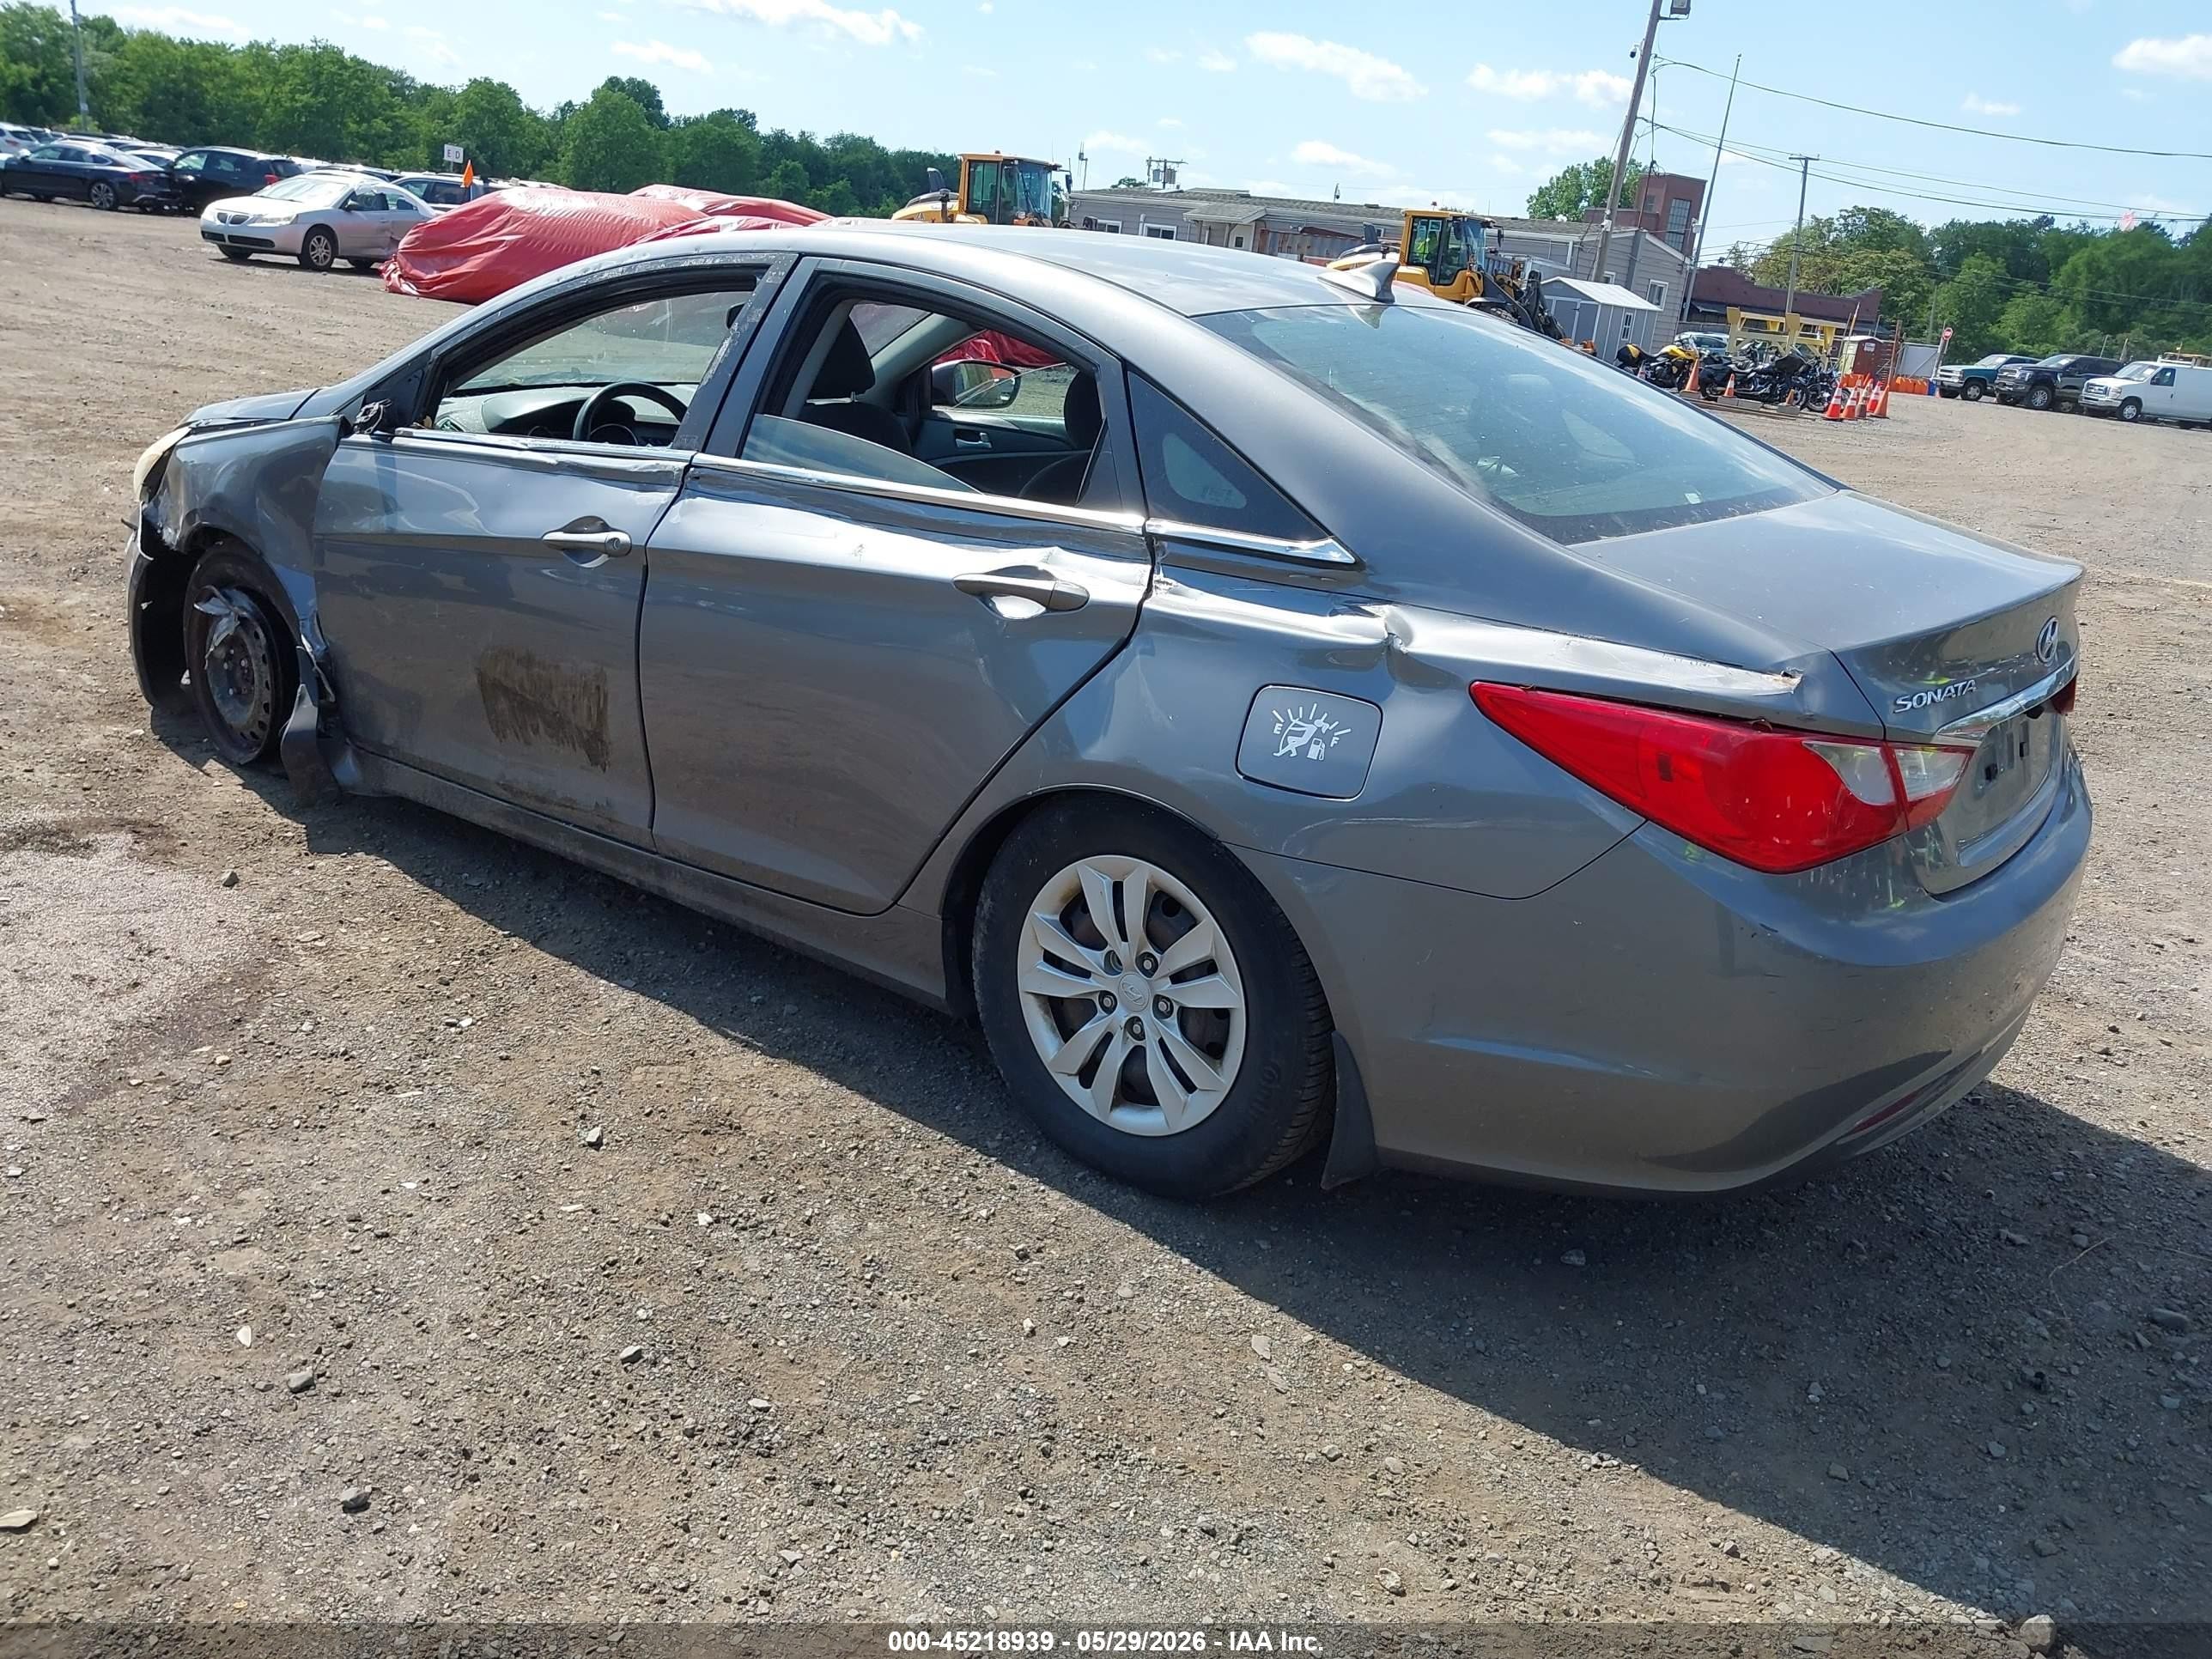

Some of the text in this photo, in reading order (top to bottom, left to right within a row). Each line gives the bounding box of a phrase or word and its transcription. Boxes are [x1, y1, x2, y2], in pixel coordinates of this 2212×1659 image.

[1894, 679, 1978, 714] SONATA
[1273, 723, 1283, 734] E
[1330, 737, 1340, 747] F
